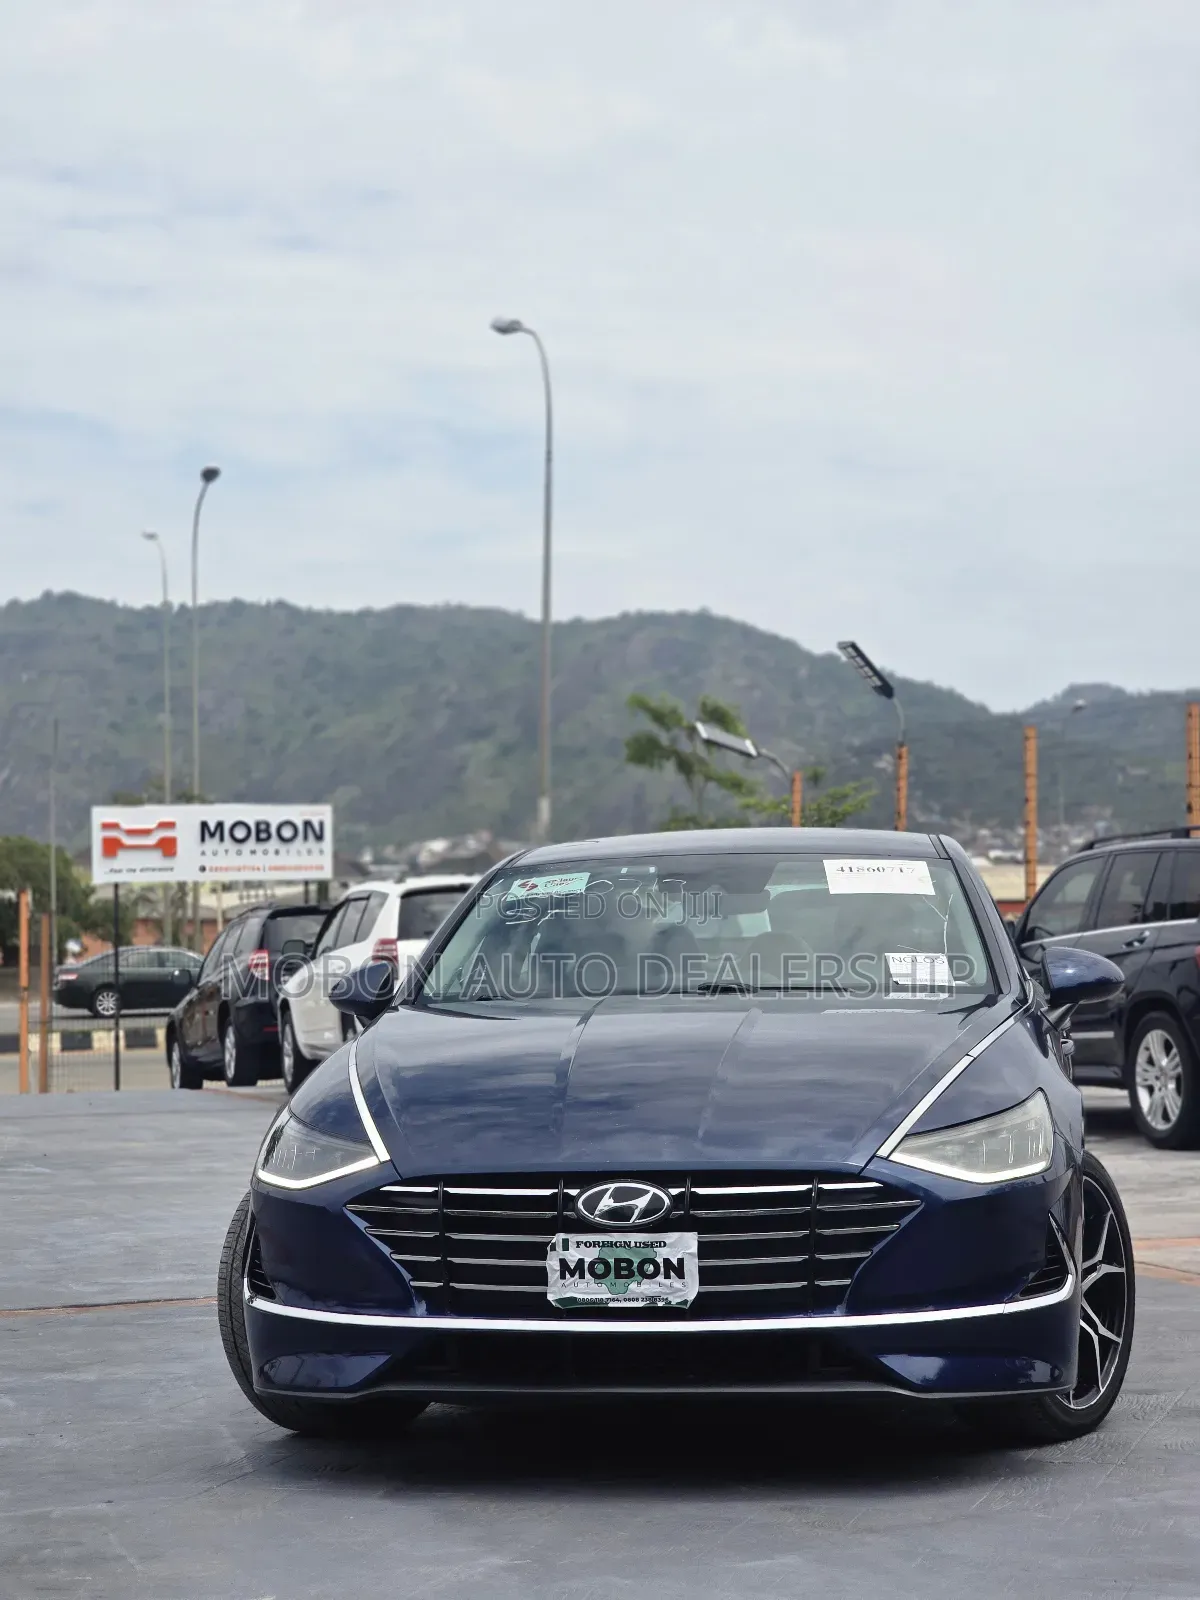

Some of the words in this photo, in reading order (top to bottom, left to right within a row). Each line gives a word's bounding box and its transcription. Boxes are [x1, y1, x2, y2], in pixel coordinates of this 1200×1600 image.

[199, 819, 325, 843] MOBON
[575, 1240, 632, 1250] FOREIGN
[633, 1240, 667, 1249] USED
[558, 1257, 686, 1280] MOBON
